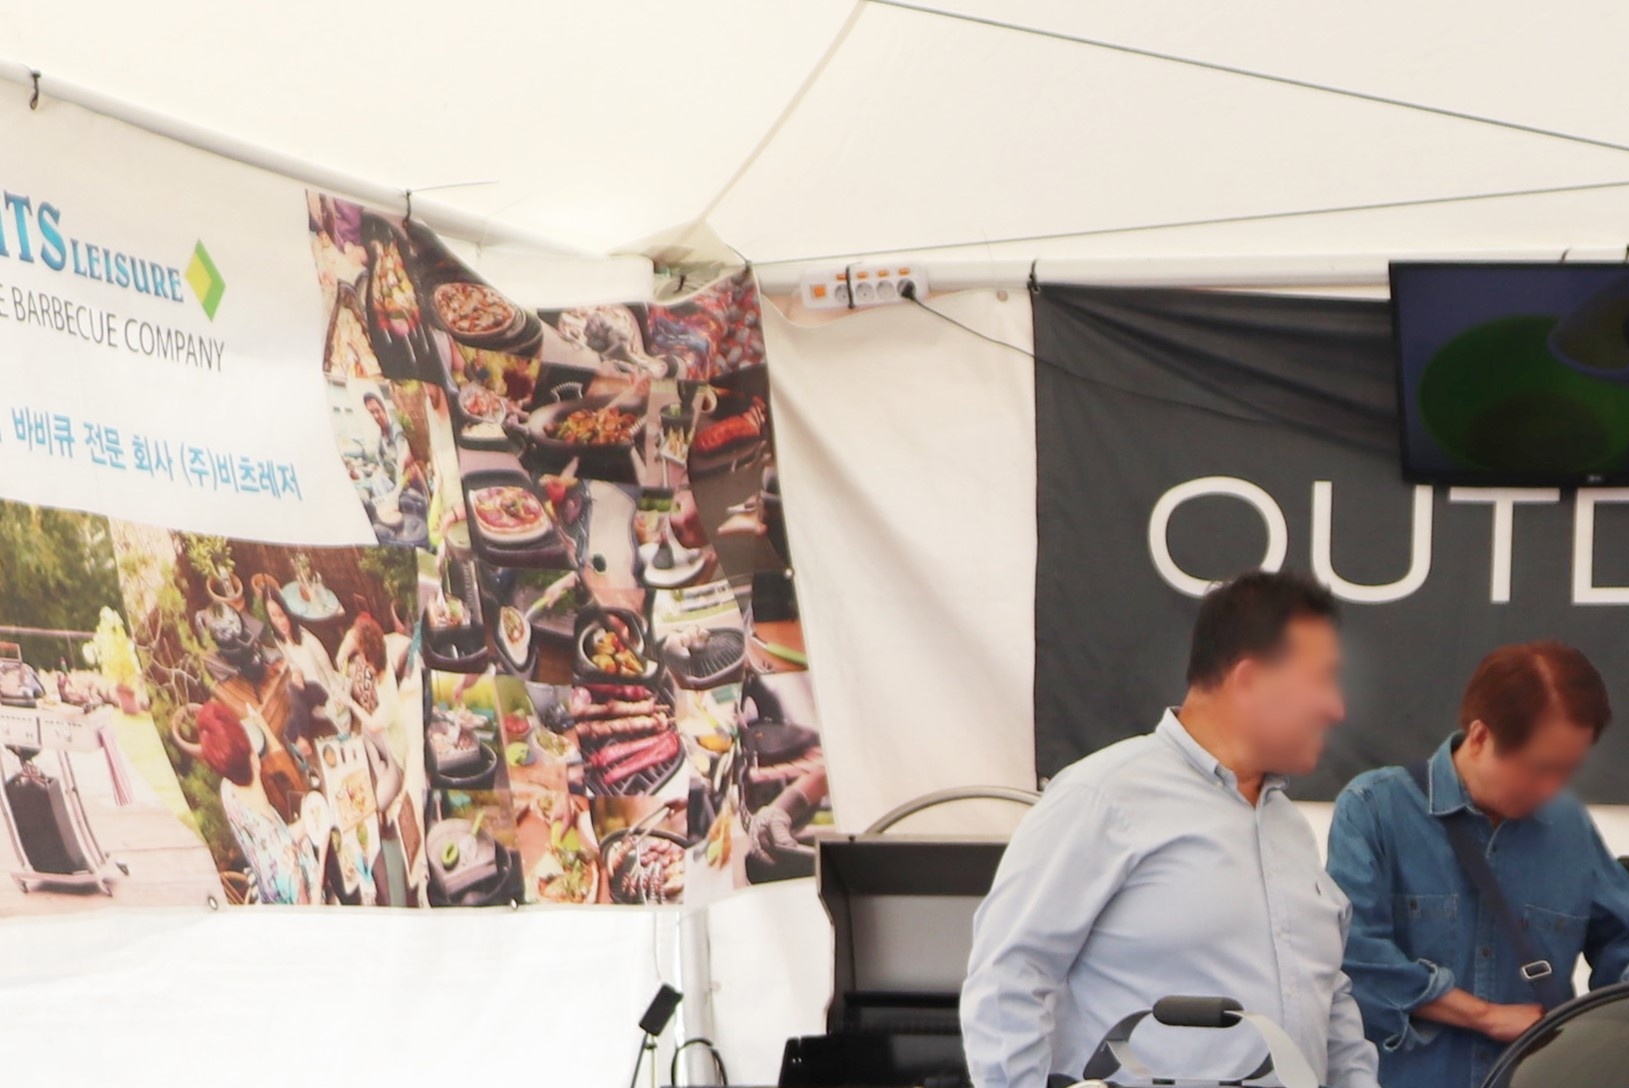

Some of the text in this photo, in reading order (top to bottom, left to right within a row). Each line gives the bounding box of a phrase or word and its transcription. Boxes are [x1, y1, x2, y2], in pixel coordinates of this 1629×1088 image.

[70, 238, 184, 303] LEISURE
[12, 286, 118, 348] BARBECUE
[125, 317, 224, 372] COMPANY
[11, 406, 303, 501] 바비큐 전문 회사 (주)비츠레저
